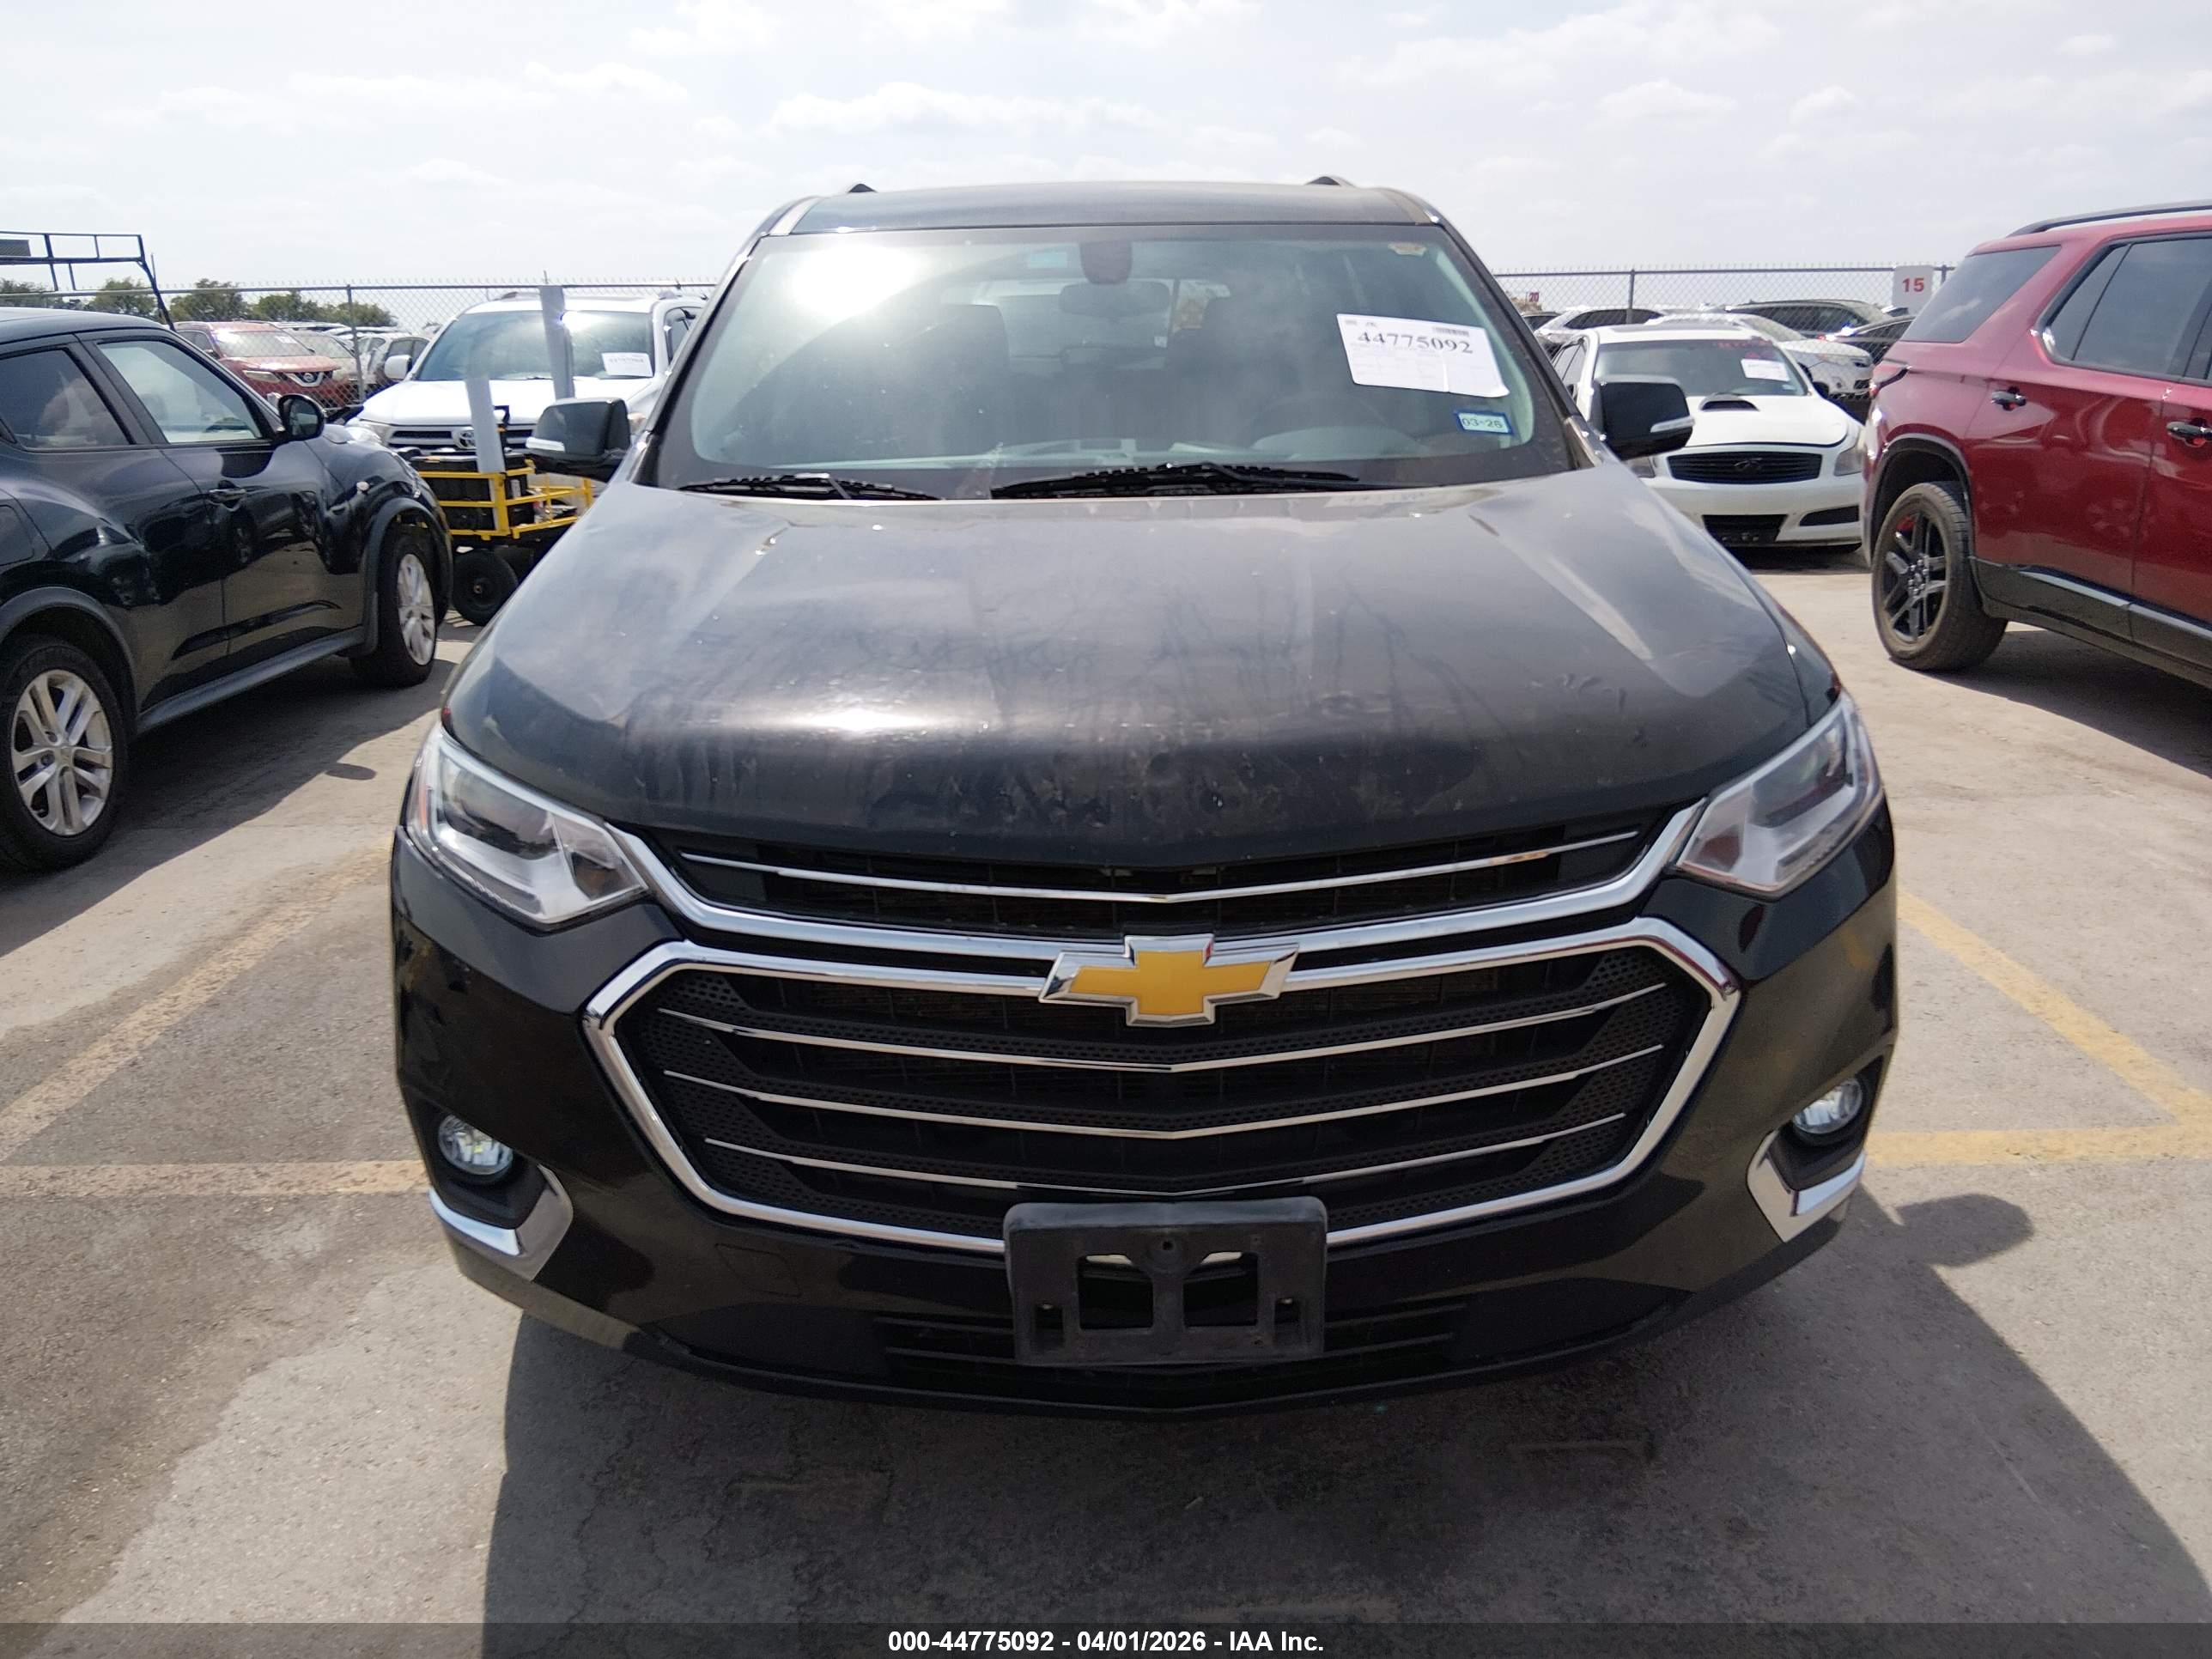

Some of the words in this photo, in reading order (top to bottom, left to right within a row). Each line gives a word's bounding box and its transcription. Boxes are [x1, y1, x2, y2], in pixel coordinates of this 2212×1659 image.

[1902, 277, 1924, 293] 15
[1528, 292, 1540, 302] 20
[1358, 331, 1474, 355] 44775092
